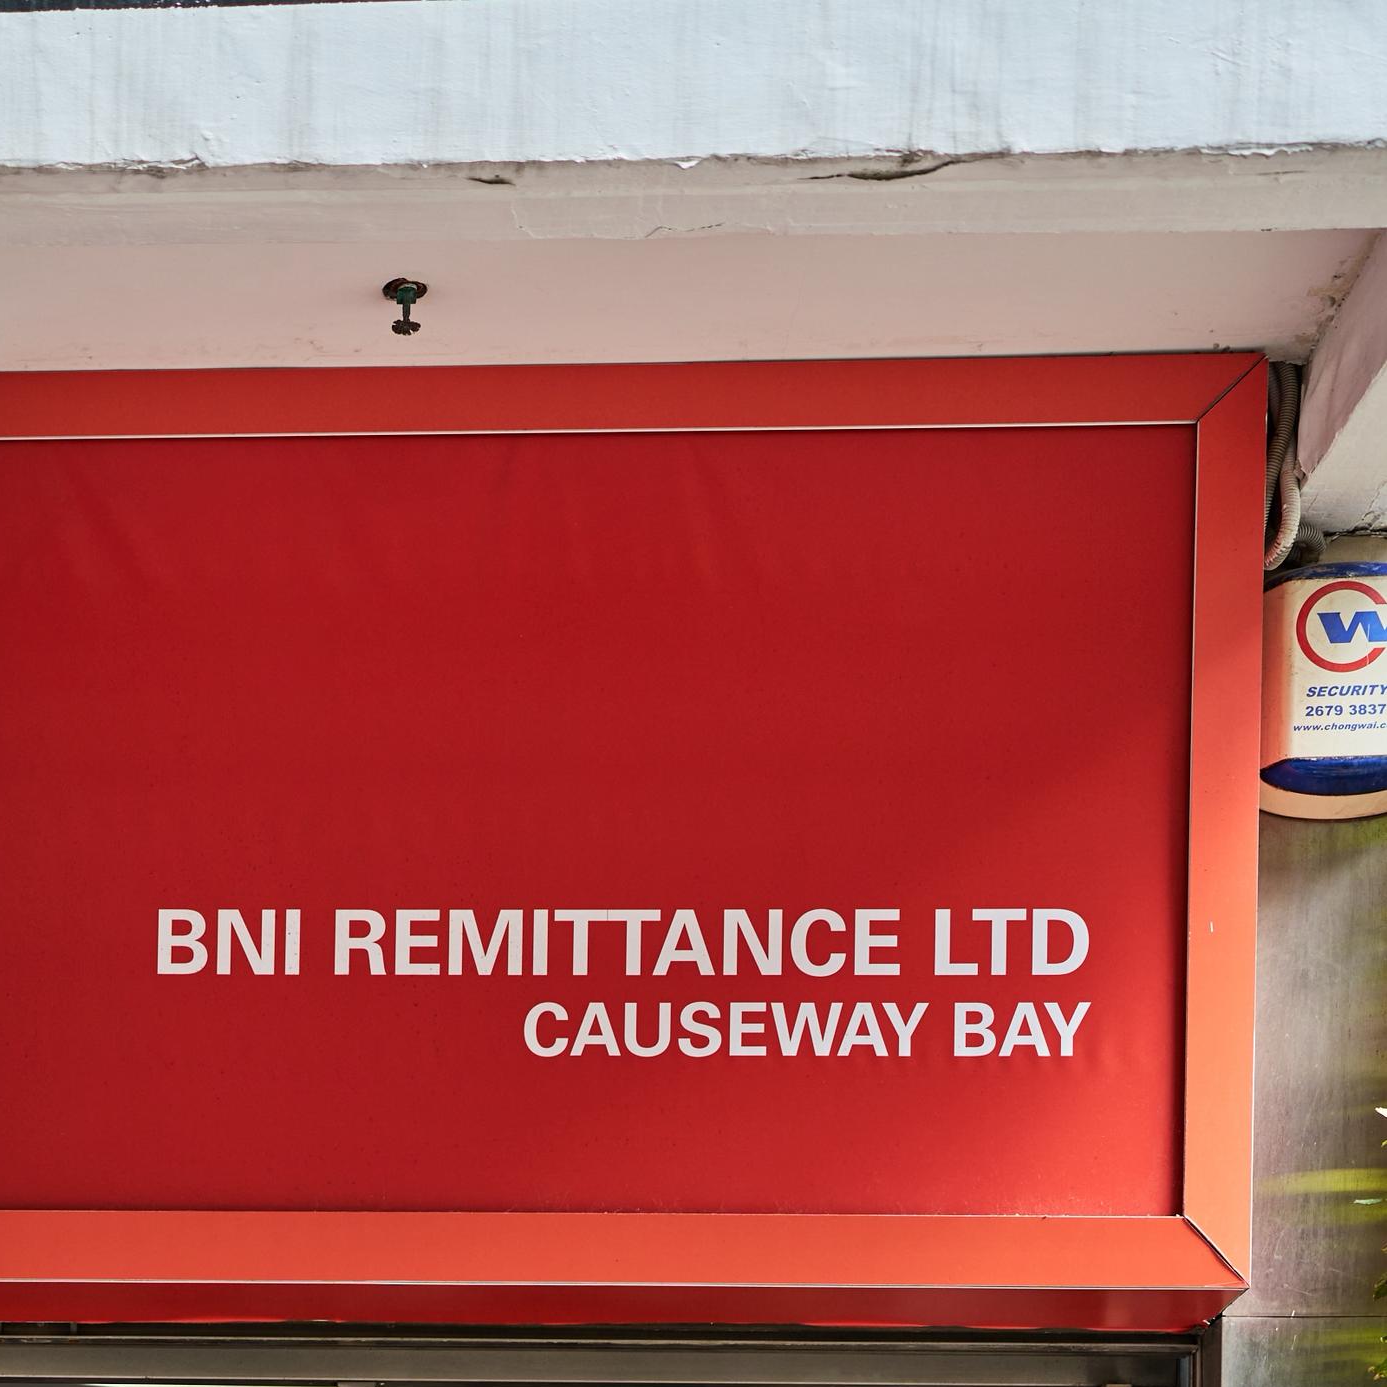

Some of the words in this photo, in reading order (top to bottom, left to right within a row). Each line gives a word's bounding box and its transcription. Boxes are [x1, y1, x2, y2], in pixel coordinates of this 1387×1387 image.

[1306, 685, 1387, 698] SECURITY
[1304, 704, 1343, 717] 2679
[1348, 703, 1386, 716] 3837
[1293, 722, 1387, 734] www.chongwai.c
[156, 908, 300, 976] BNI
[334, 908, 901, 978] REMITTANCE
[934, 908, 1090, 976] LTD
[523, 1001, 929, 1058] CAUSEWAY
[953, 1002, 1092, 1057] BAY
